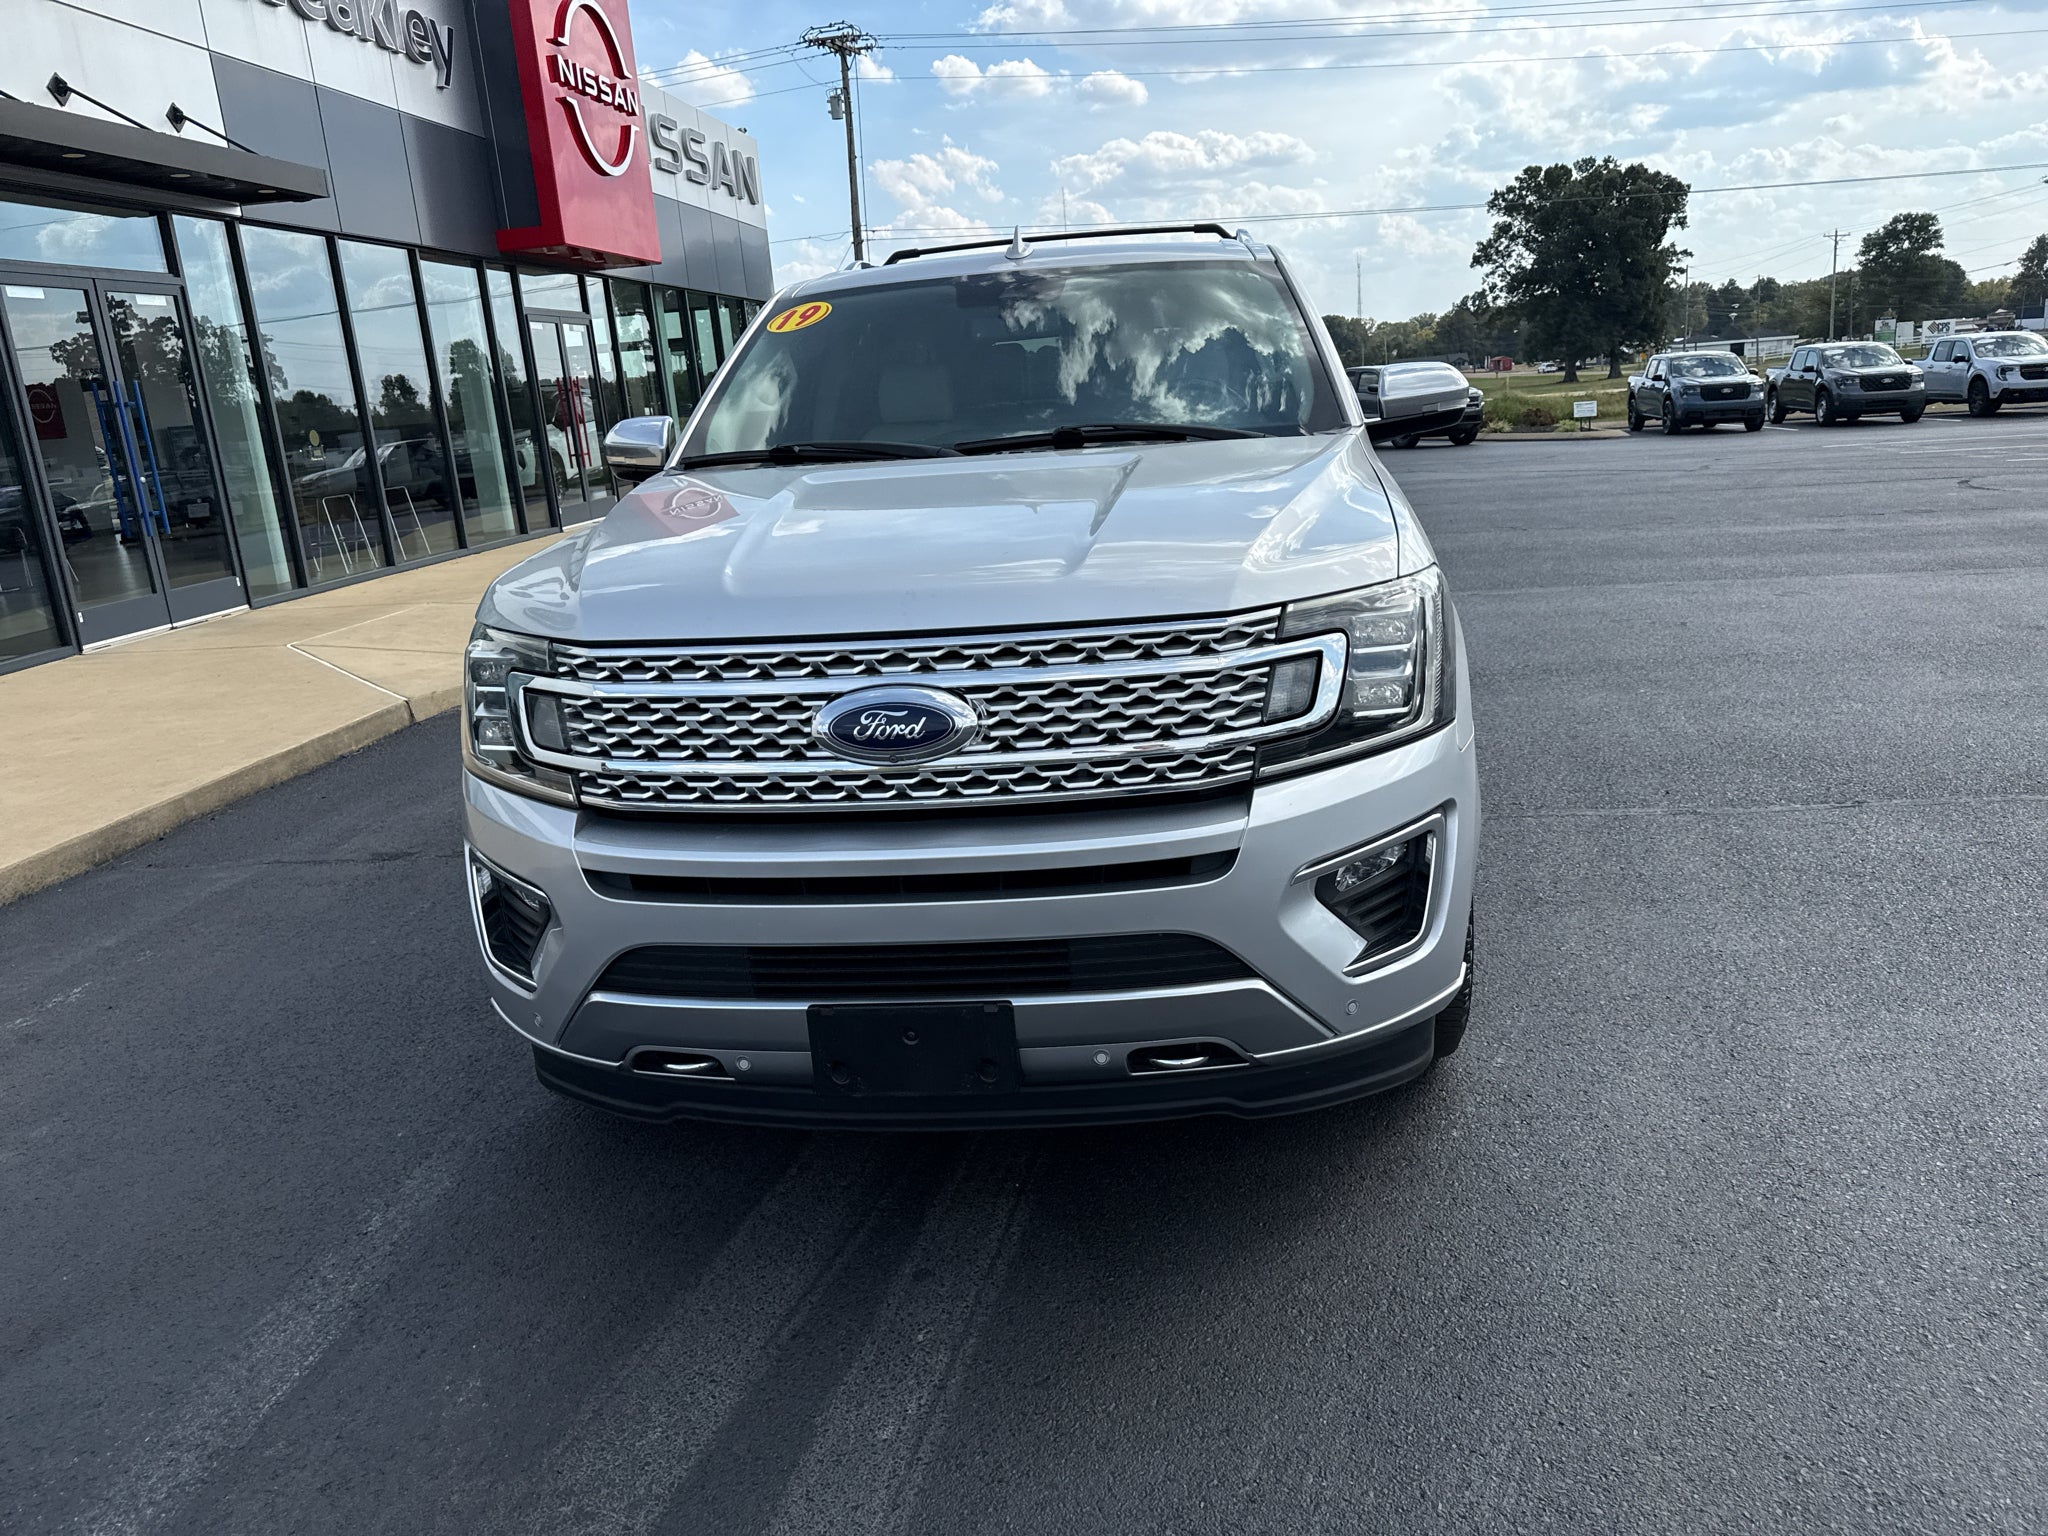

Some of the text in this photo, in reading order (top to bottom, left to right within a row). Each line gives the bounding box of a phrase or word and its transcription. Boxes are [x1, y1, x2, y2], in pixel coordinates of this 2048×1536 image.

[262, 0, 454, 88] akley
[550, 54, 639, 116] NISSAN
[776, 305, 821, 331] 19
[853, 710, 927, 741] Ford
